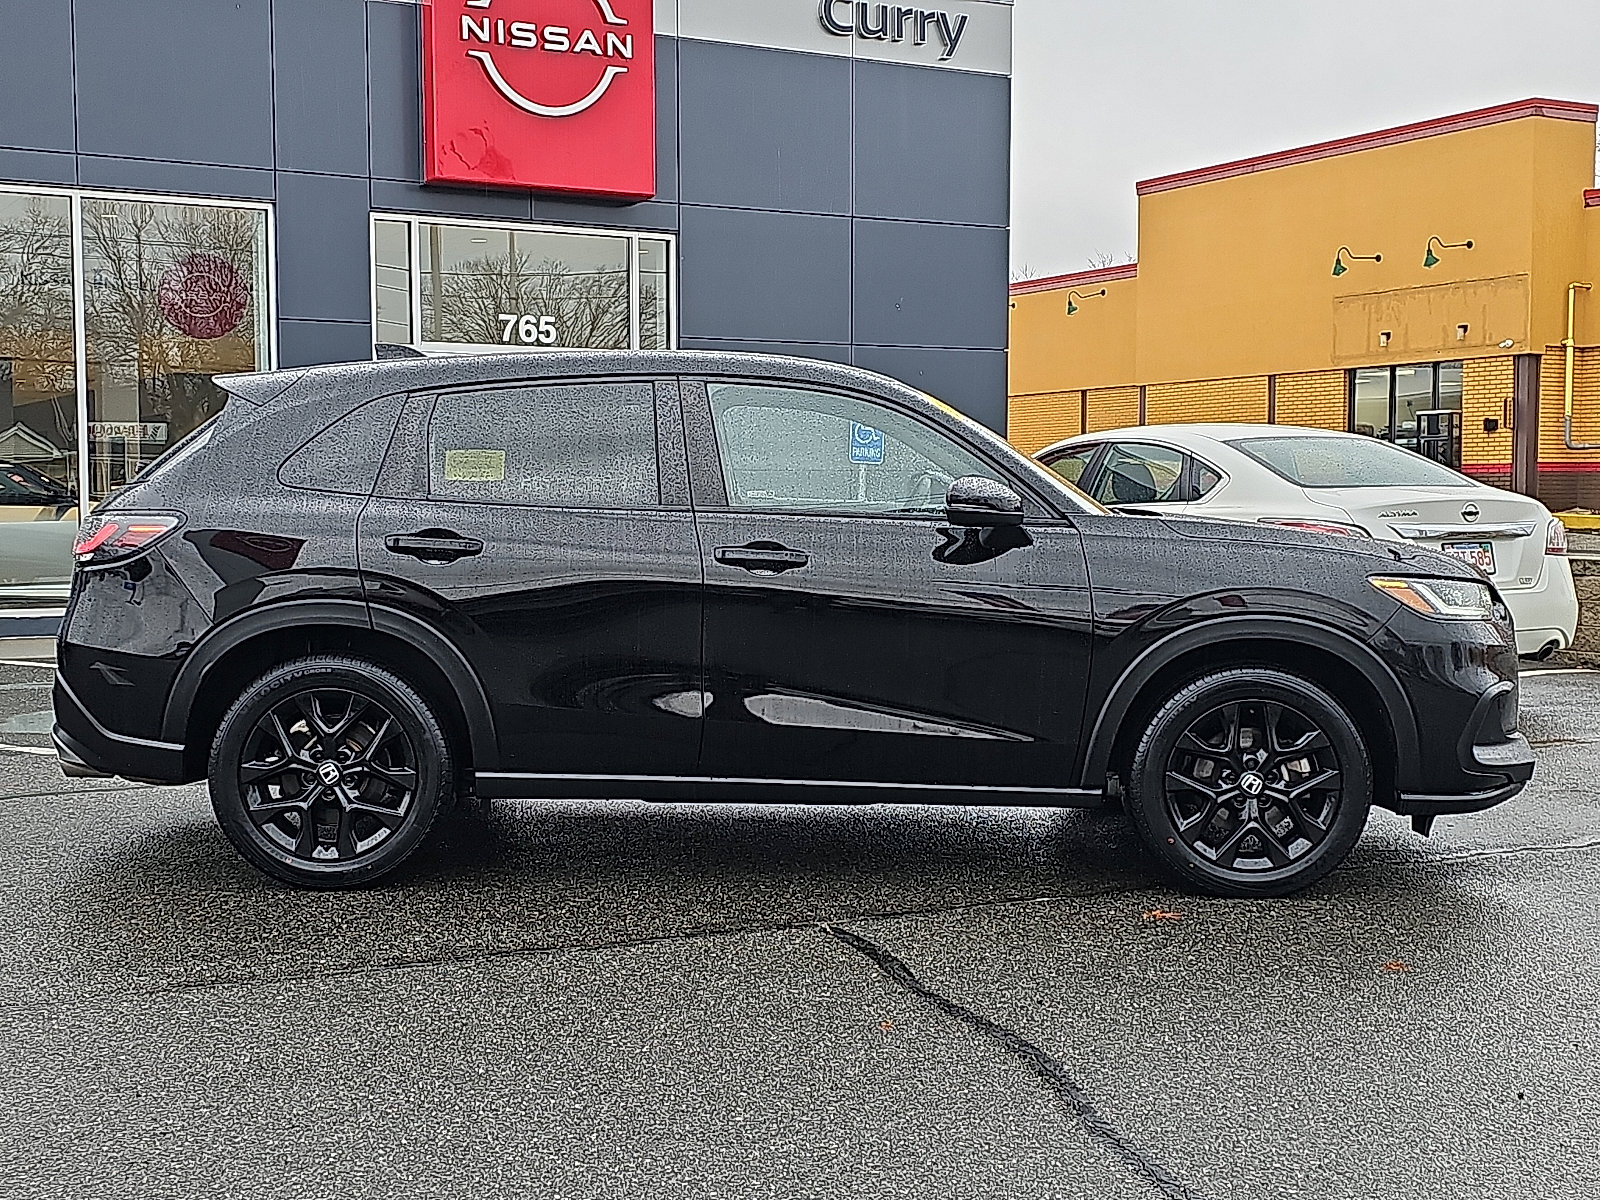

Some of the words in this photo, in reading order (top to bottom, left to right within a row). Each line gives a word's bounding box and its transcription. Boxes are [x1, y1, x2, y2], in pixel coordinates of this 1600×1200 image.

[460, 14, 633, 59] NISSAN
[819, 0, 969, 60] Curry
[498, 313, 557, 344] 765
[852, 446, 881, 458] PARKING
[1470, 550, 1491, 567] 585
